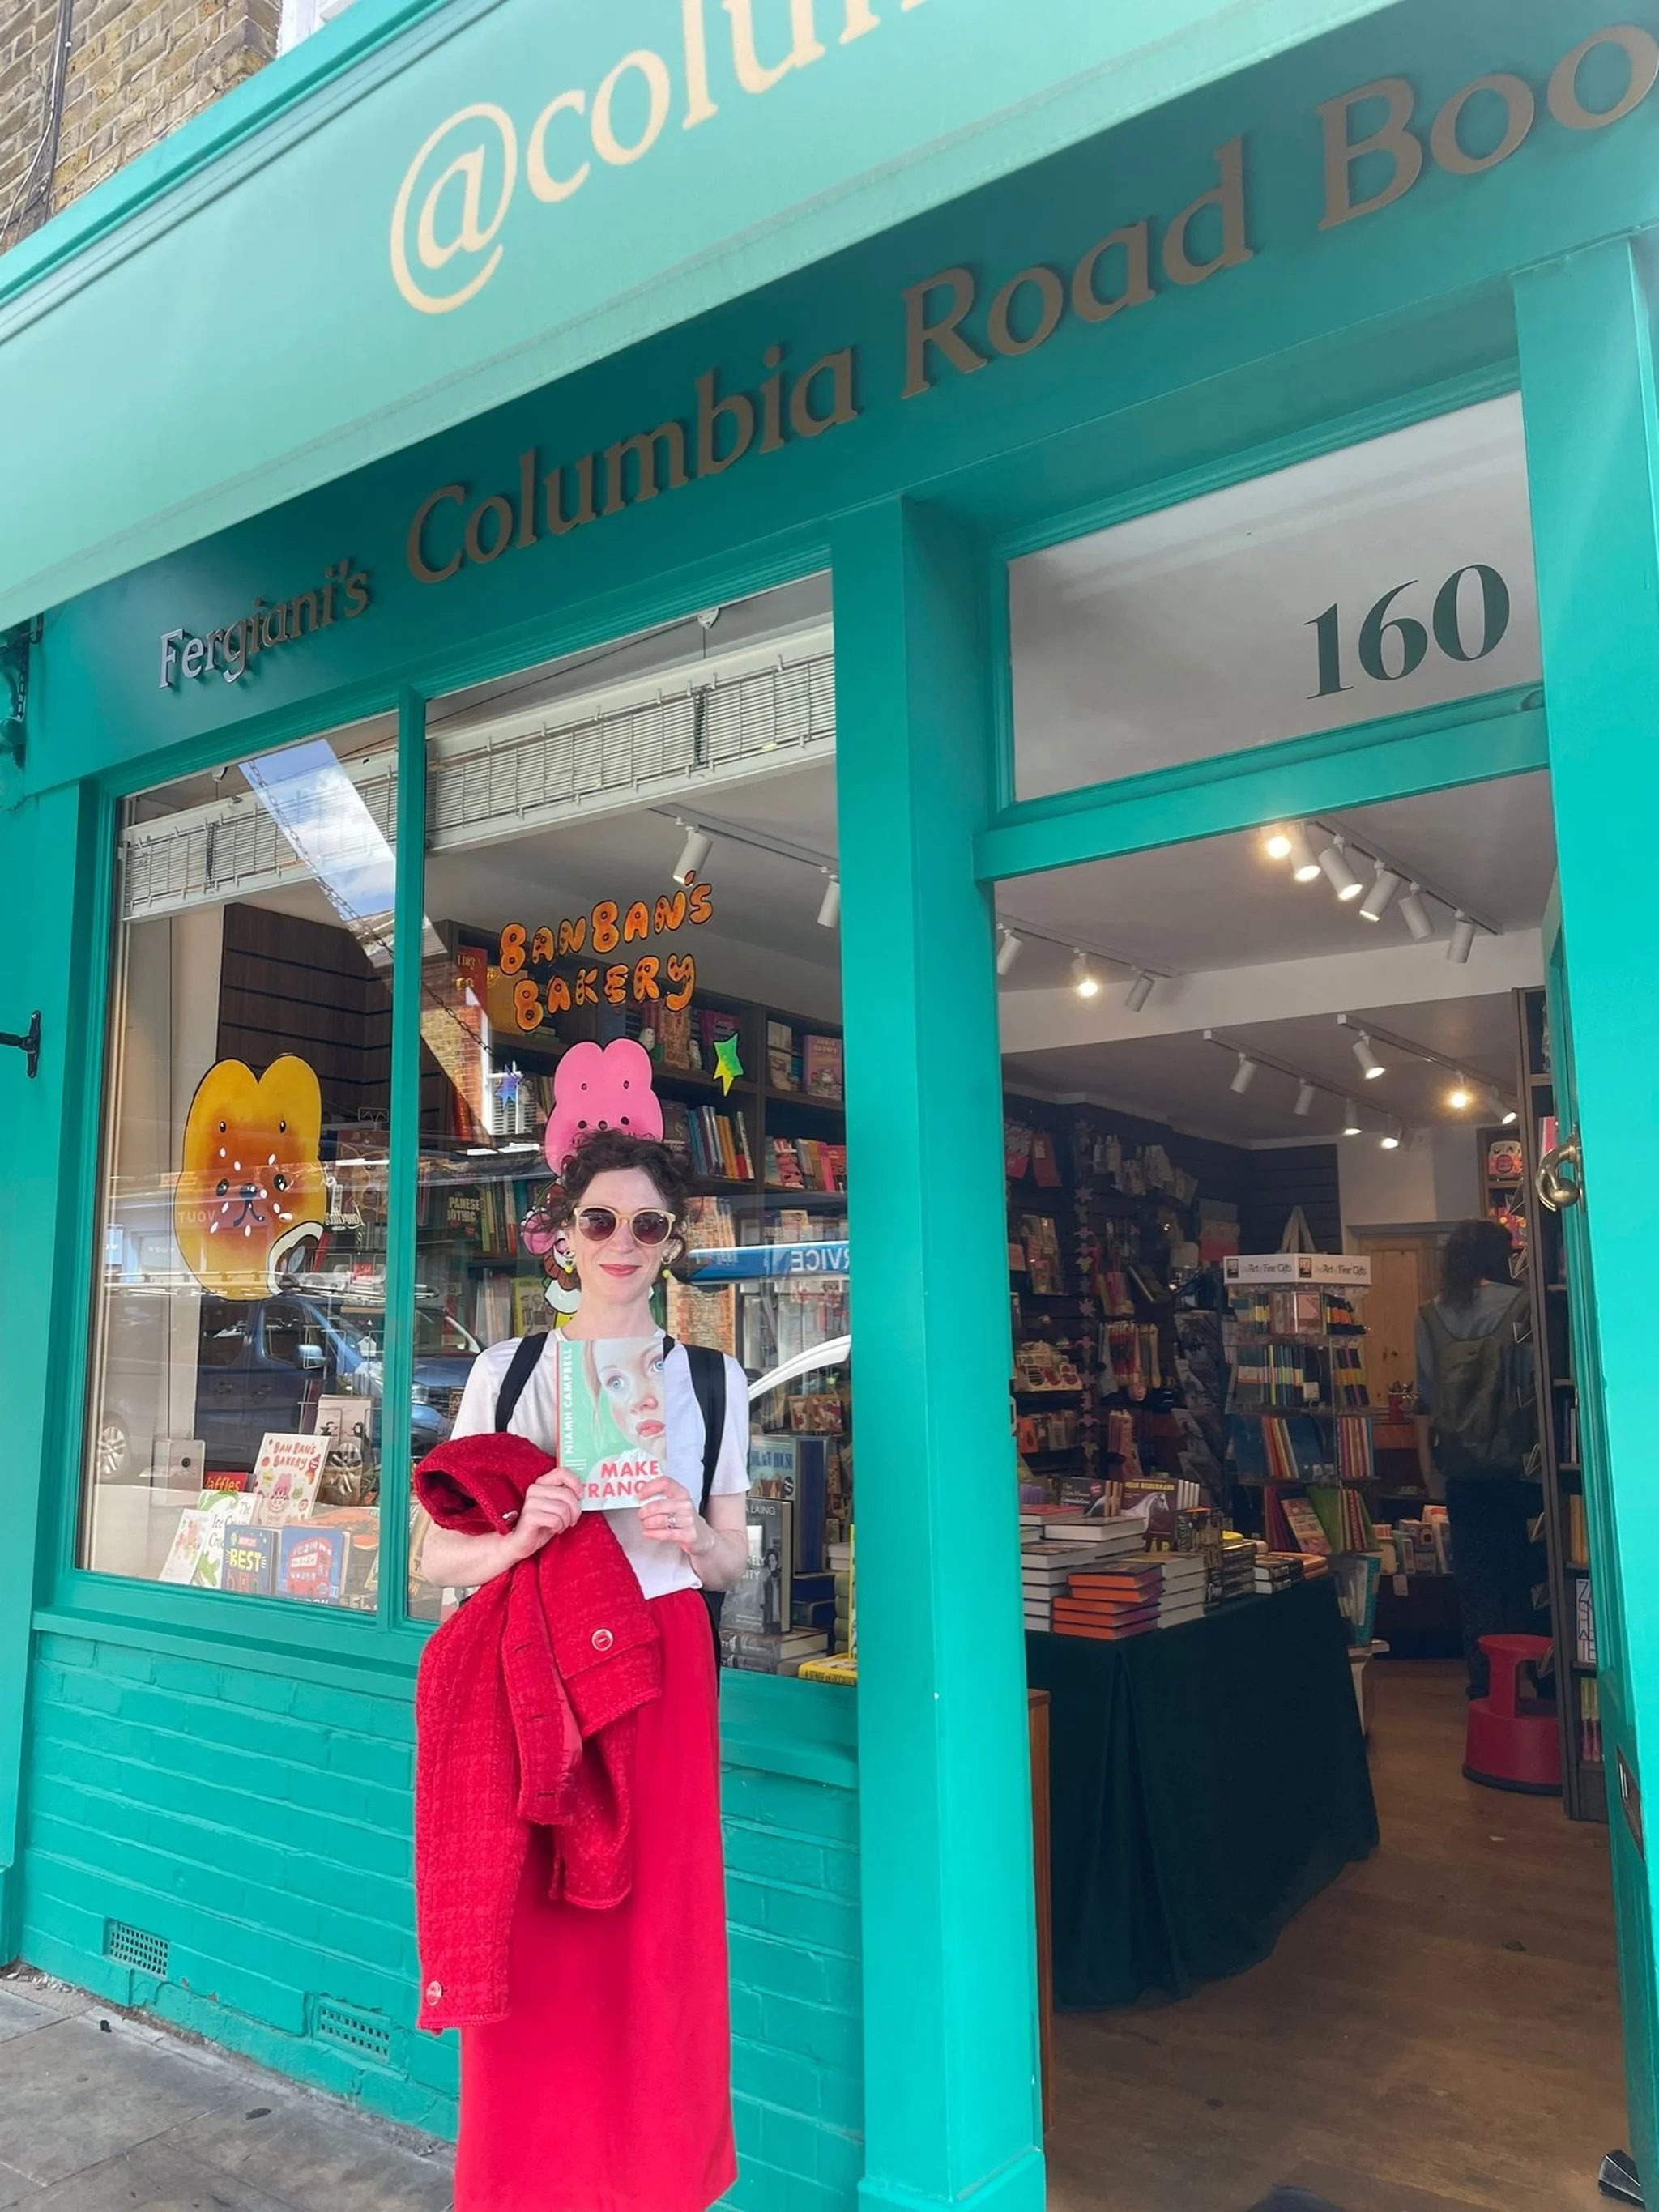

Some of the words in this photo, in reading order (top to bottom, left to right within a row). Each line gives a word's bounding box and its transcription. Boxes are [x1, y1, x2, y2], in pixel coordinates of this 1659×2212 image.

[390, 0, 928, 314] @colu
[159, 558, 370, 688] Fergiani's
[407, 343, 859, 583] Columbia
[902, 135, 1254, 399] Road
[1316, 24, 1659, 230] Boo
[1305, 563, 1510, 700] 160
[562, 1348, 573, 1409] CAMPBELL
[564, 1412, 574, 1455] NIAMH
[601, 1460, 659, 1478] MAKE
[229, 1547, 262, 1572] BEST
